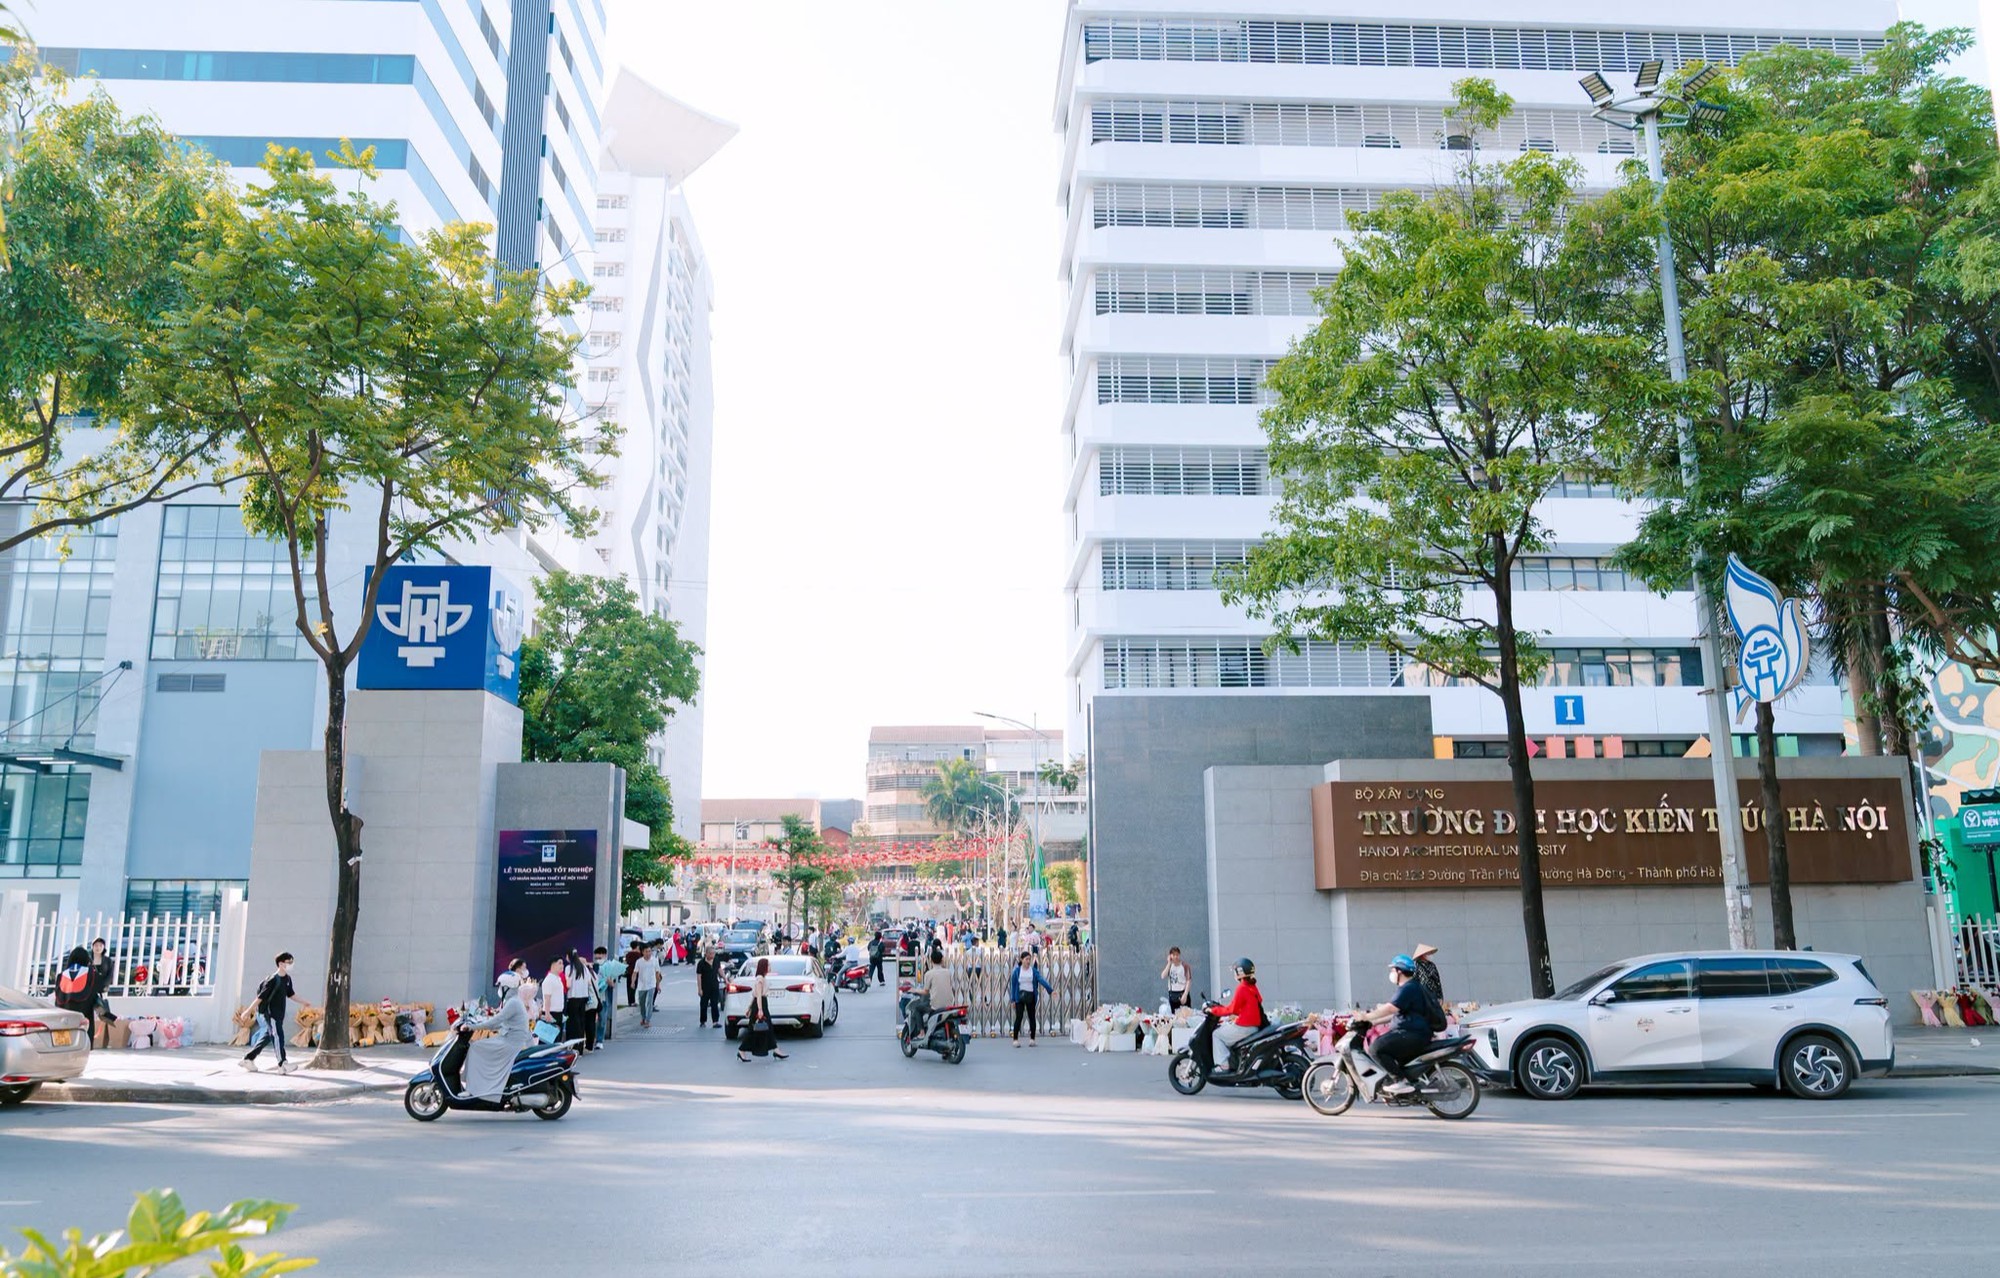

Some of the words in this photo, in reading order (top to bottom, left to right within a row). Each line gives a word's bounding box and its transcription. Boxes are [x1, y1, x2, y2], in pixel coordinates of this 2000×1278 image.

[1355, 786, 1374, 802] BỘ
[1378, 786, 1402, 800] XÂY
[1357, 803, 1485, 836] TRƯỜNG
[1493, 809, 1548, 834] ĐI
[1555, 808, 1618, 842] HỌC
[1623, 793, 1695, 834] KIẾN
[1701, 799, 1768, 833] TÚ
[1787, 799, 1832, 832] HÀ
[1836, 797, 1889, 840] NỘI
[1358, 846, 1400, 858] HANOI
[1402, 845, 1500, 857] ARCHITECTURAL
[1360, 870, 1380, 883] Địa
[1469, 866, 1495, 881] Trần
[1576, 866, 1592, 879] Hà
[1636, 865, 1673, 878] Thành
[1676, 865, 1698, 880] phố
[1700, 865, 1716, 878] Hà
